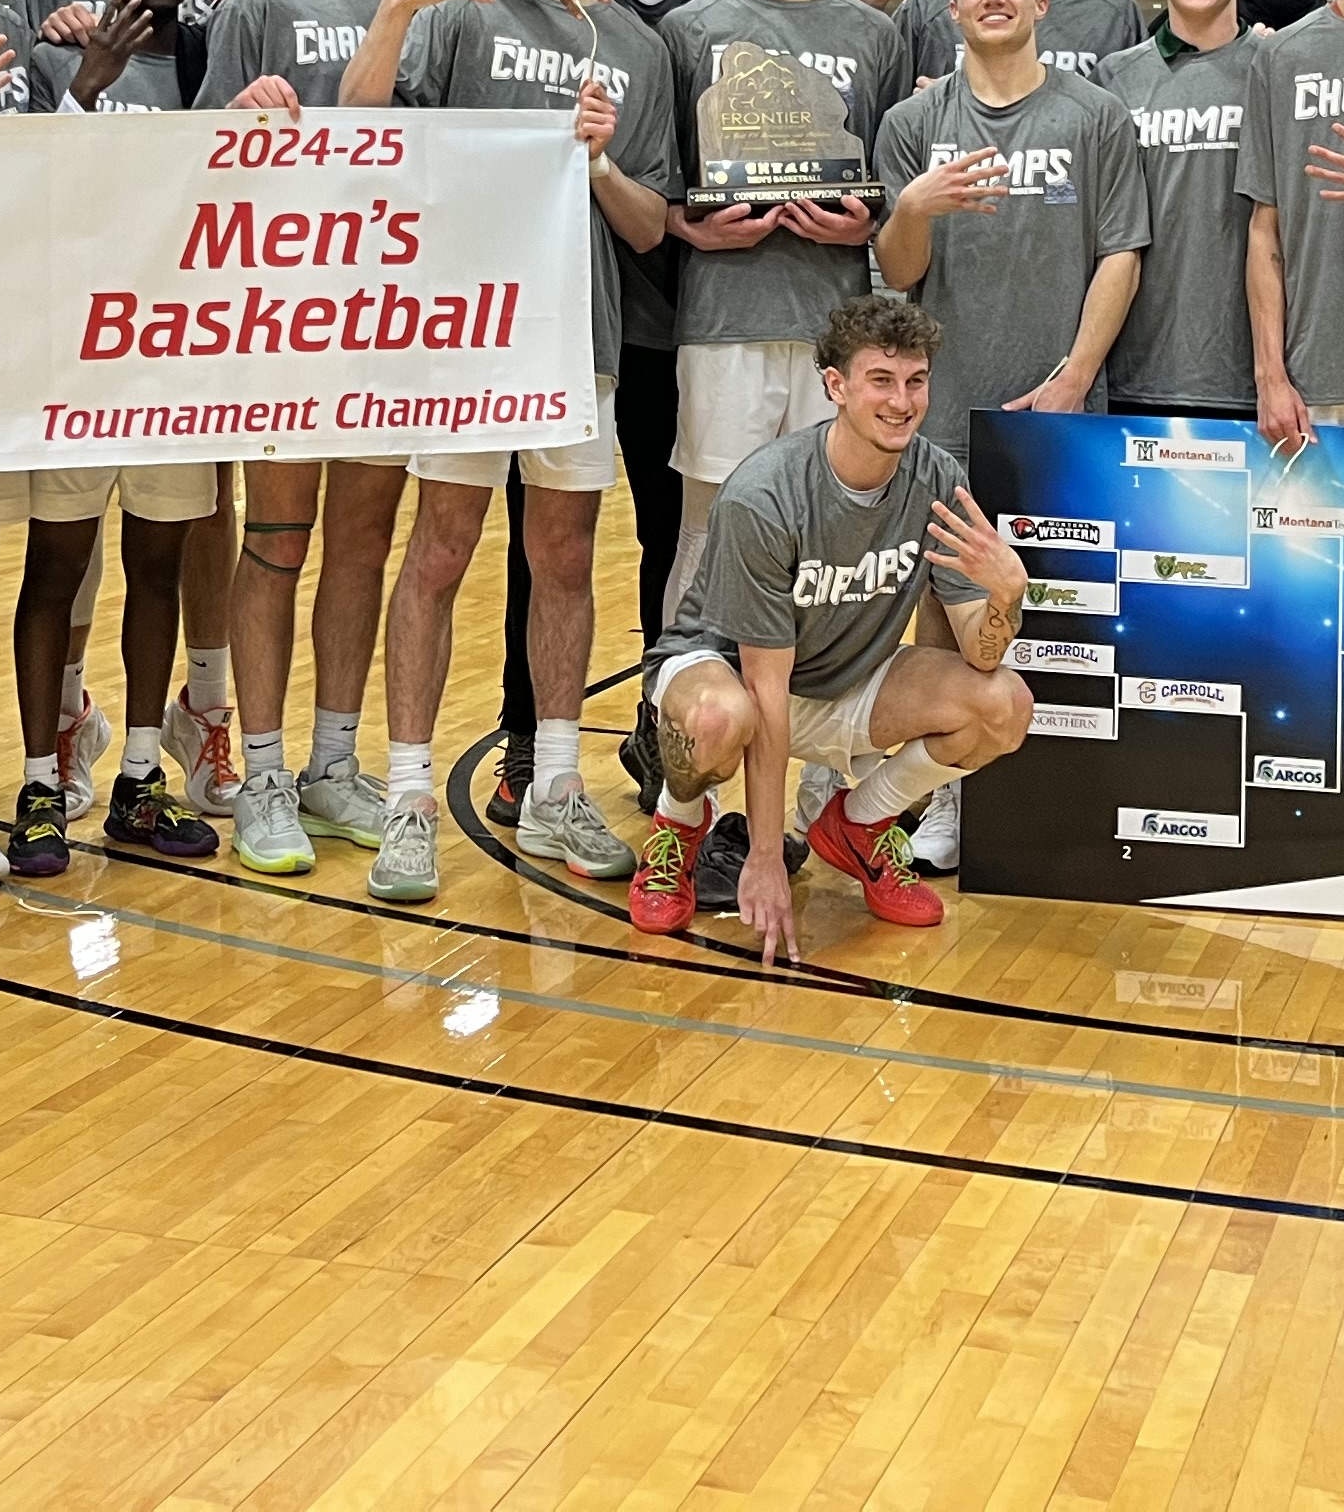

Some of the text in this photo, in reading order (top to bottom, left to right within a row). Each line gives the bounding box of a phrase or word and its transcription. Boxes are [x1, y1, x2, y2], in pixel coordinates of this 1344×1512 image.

[721, 111, 812, 126] FRONTIER
[1135, 105, 1244, 148] HAMP
[208, 128, 405, 169] 2024-25
[733, 190, 790, 202] CONFERENCE
[790, 188, 842, 200] CHAMPIONS
[179, 199, 420, 270] Men's
[79, 283, 520, 360] Basketball
[42, 389, 567, 441] Tournament Champions
[1133, 474, 1140, 488] 1
[1038, 526, 1099, 543] WESTERN
[1036, 643, 1098, 663] CARROLL
[1161, 683, 1225, 702] CARROLL
[1031, 715, 1098, 730] NORTHERN
[1274, 769, 1323, 784] ARGOS
[1159, 823, 1208, 838] ARGOS
[1122, 845, 1132, 860] 2
